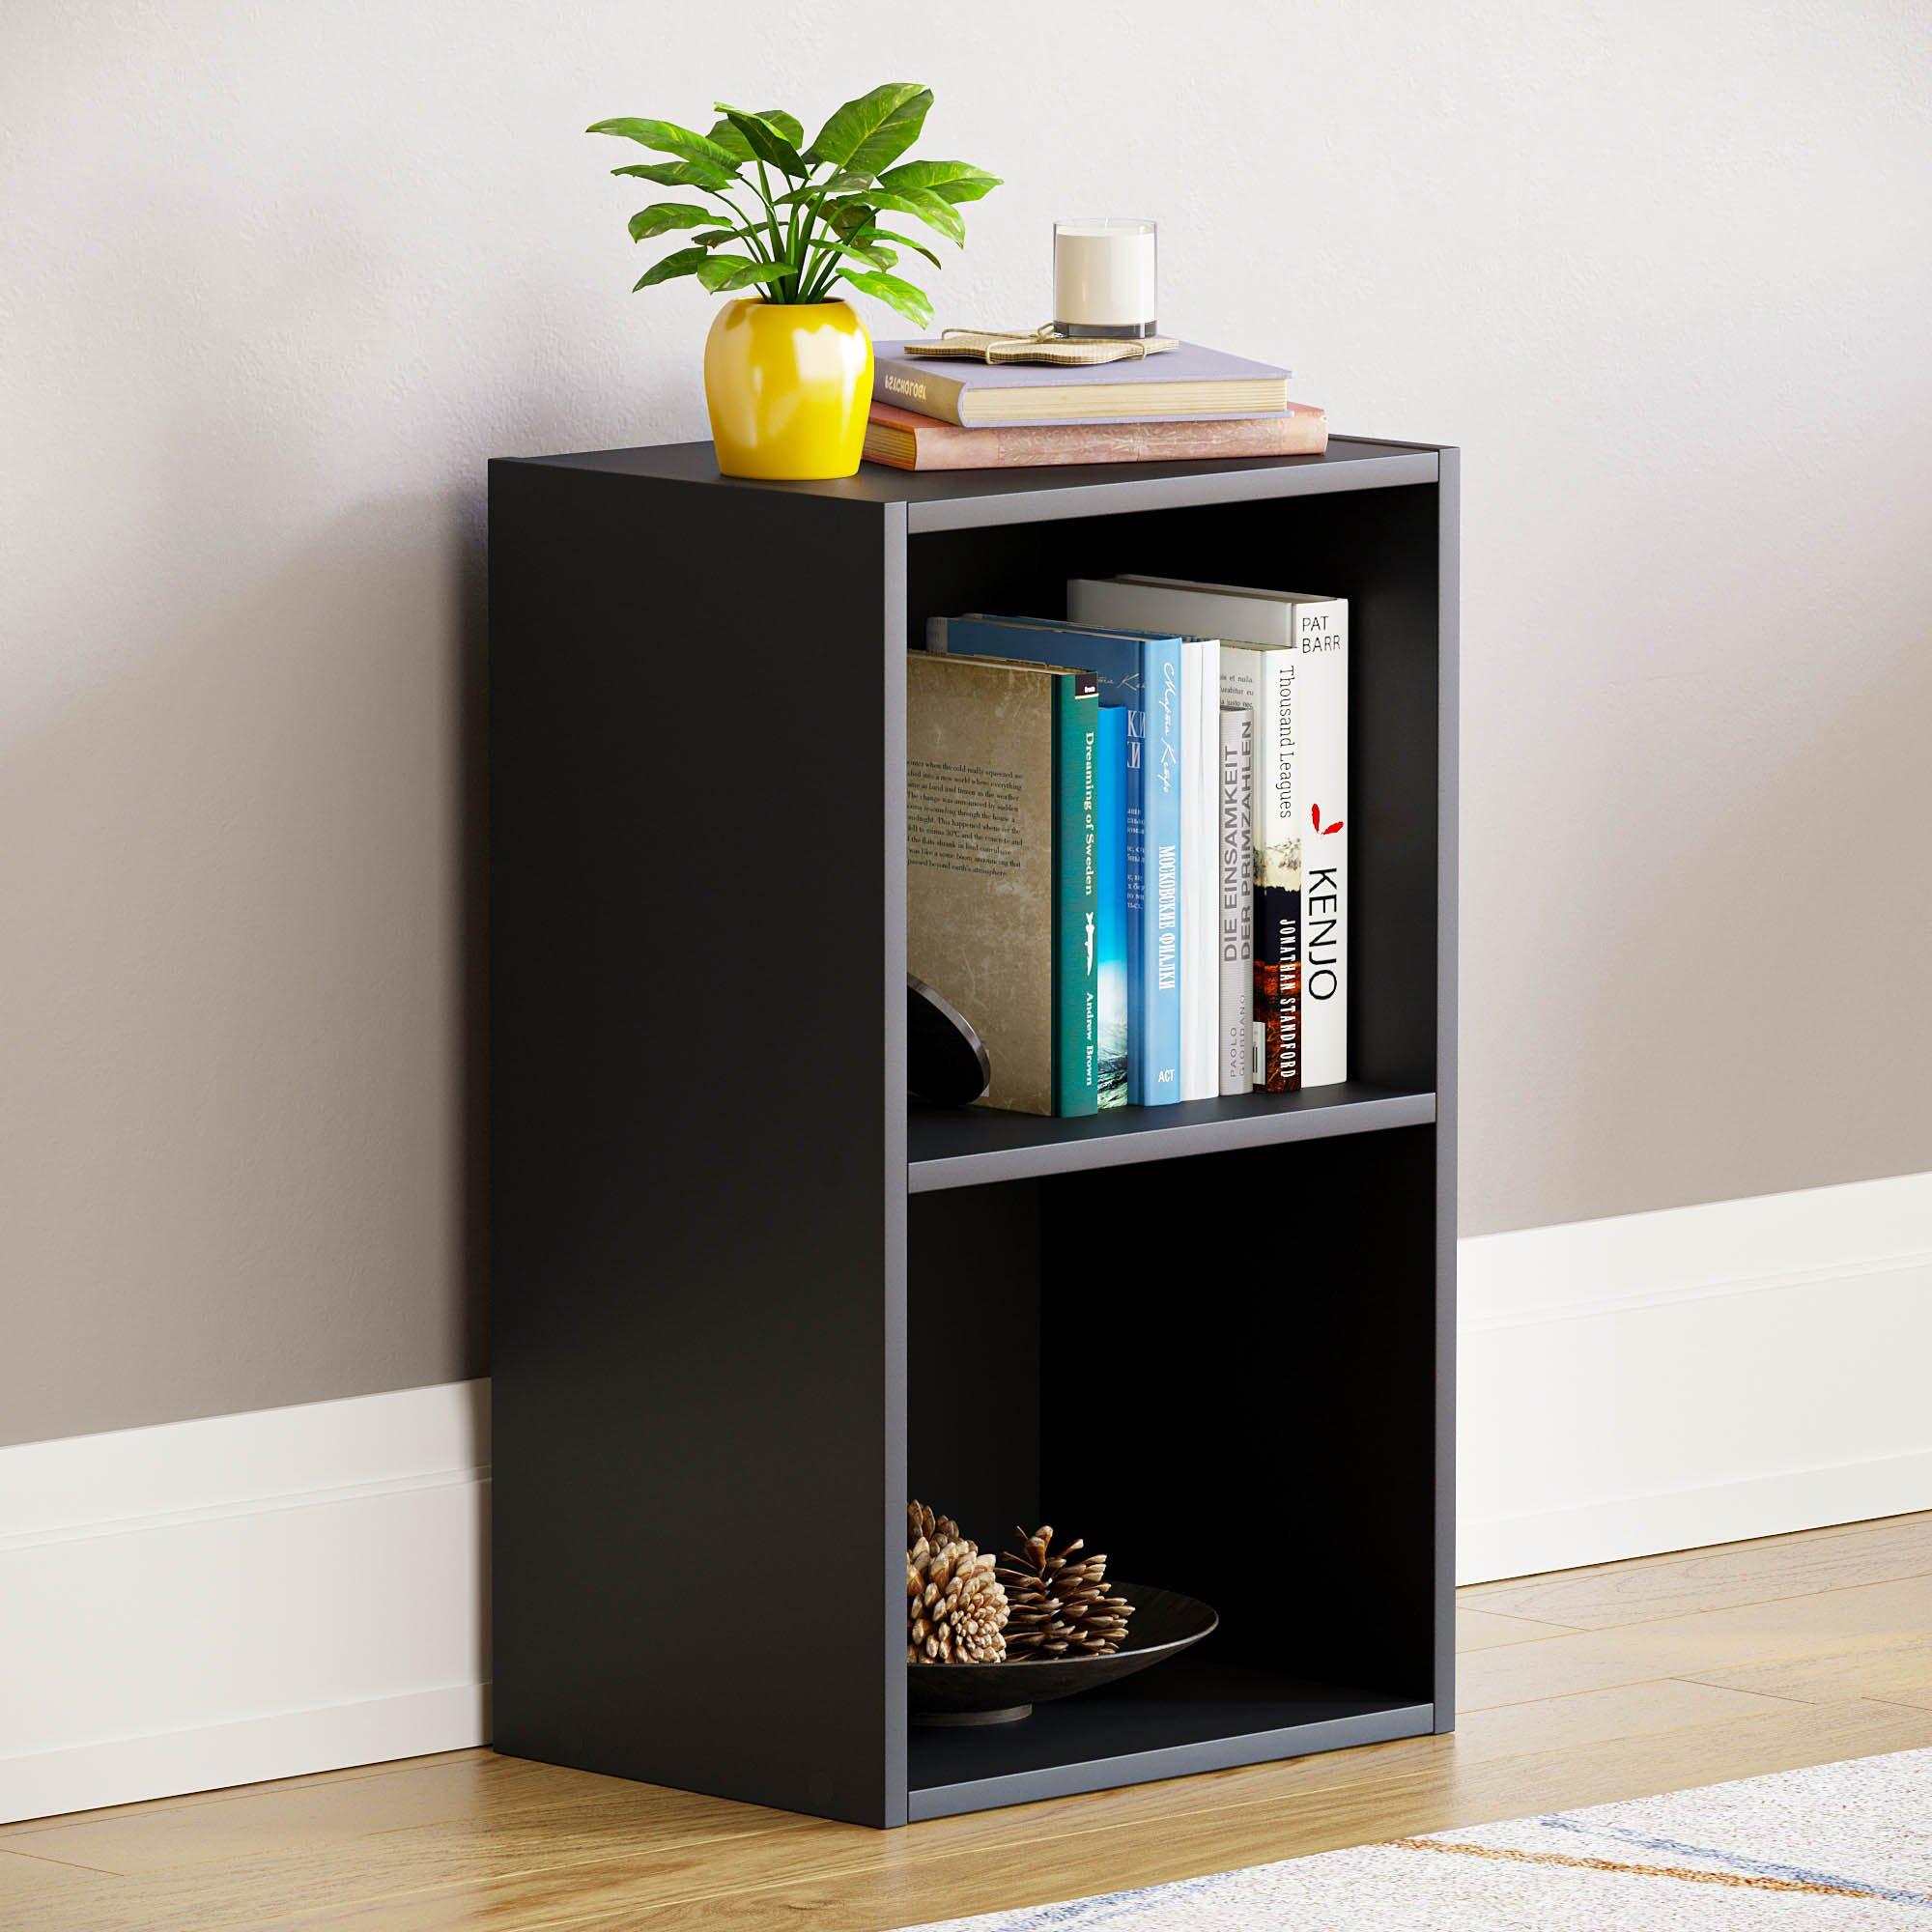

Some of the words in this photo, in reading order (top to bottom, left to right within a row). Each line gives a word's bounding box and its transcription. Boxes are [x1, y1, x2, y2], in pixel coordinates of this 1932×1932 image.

[1302, 615, 1329, 632] PAT
[1302, 635, 1341, 654] BARR
[1279, 666, 1295, 747] Thousand
[1083, 731, 1094, 810] Dreaming
[1275, 752, 1294, 818] Leagues
[1085, 814, 1094, 832] of
[1224, 746, 1237, 910] EINSAMKEIT
[1241, 721, 1252, 896] PRIMZAHLEN
[1085, 833, 1094, 896] Sweden
[1159, 845, 1176, 929] МОСКОВСКИЕ
[1159, 932, 1176, 990] ФИАЛКИ
[1224, 919, 1237, 962] DIE
[1241, 905, 1251, 960] DER
[1279, 919, 1296, 990] JONATHAN
[1308, 867, 1338, 1001] KENJO
[1086, 992, 1094, 1041] Andrew
[1279, 998, 1296, 1078] STANDFORD
[1086, 1045, 1094, 1087] Brown
[1157, 1068, 1176, 1083] АСТ
